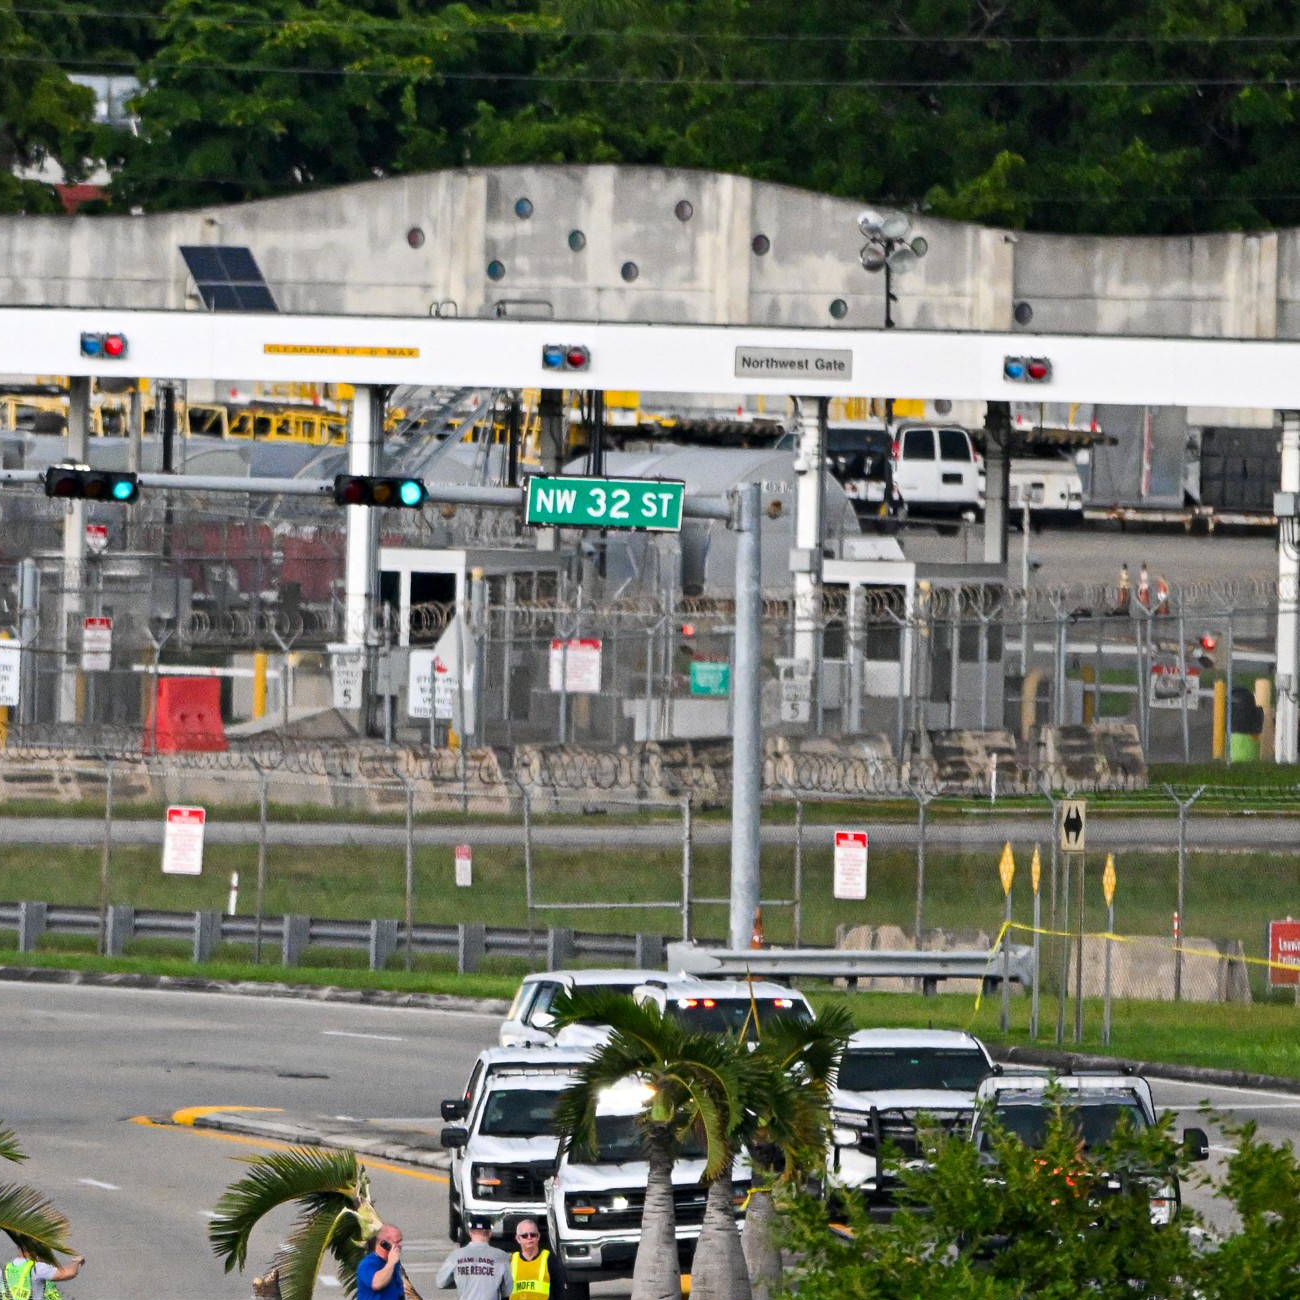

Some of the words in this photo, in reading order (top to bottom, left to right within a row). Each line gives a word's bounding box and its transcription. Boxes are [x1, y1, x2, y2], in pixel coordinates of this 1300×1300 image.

[741, 356, 809, 371] Northwest
[814, 358, 846, 372] Gate
[536, 488, 577, 514] NW
[587, 488, 630, 519] 32
[641, 493, 674, 518] ST
[343, 688, 352, 704] 5
[457, 1266, 470, 1275] FIRE
[470, 1266, 495, 1277] RESCUE
[516, 1281, 536, 1291] MDFR
